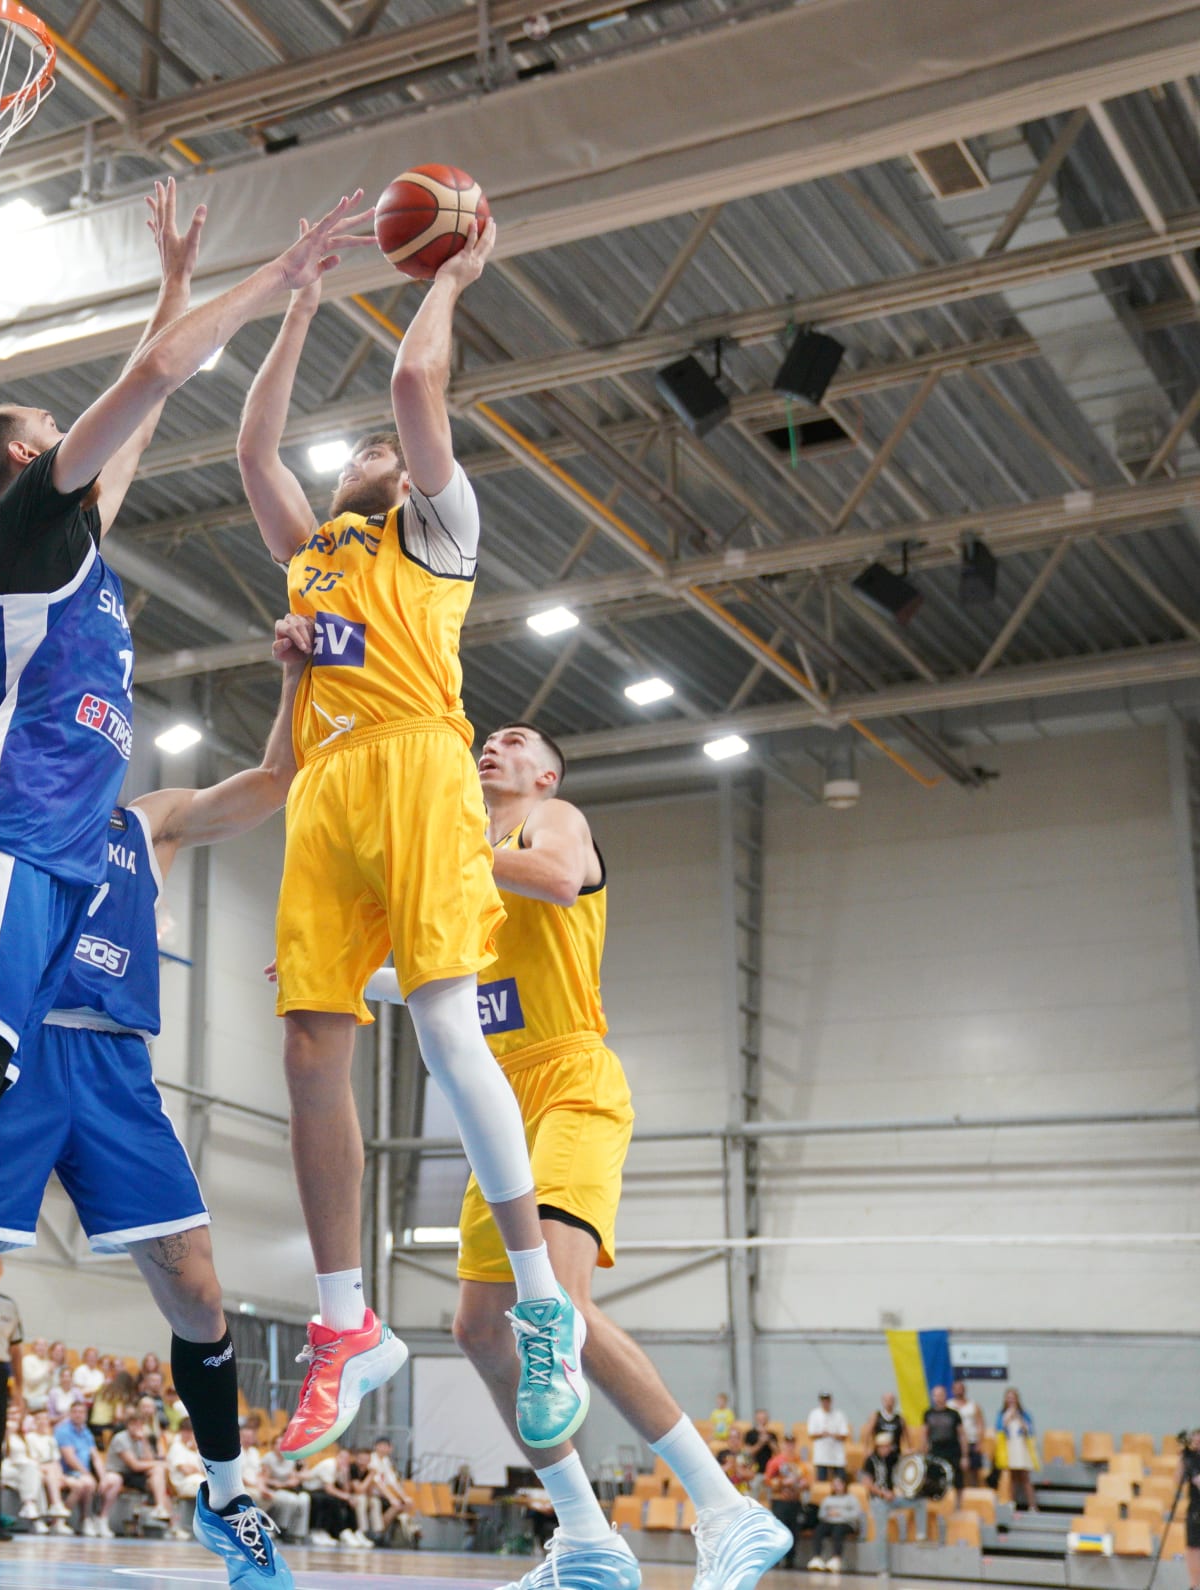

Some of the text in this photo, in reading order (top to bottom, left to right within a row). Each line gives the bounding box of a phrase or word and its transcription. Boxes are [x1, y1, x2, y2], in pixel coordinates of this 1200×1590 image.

[313, 623, 354, 656] GV
[119, 649, 133, 703] 1
[477, 989, 508, 1025] GV
